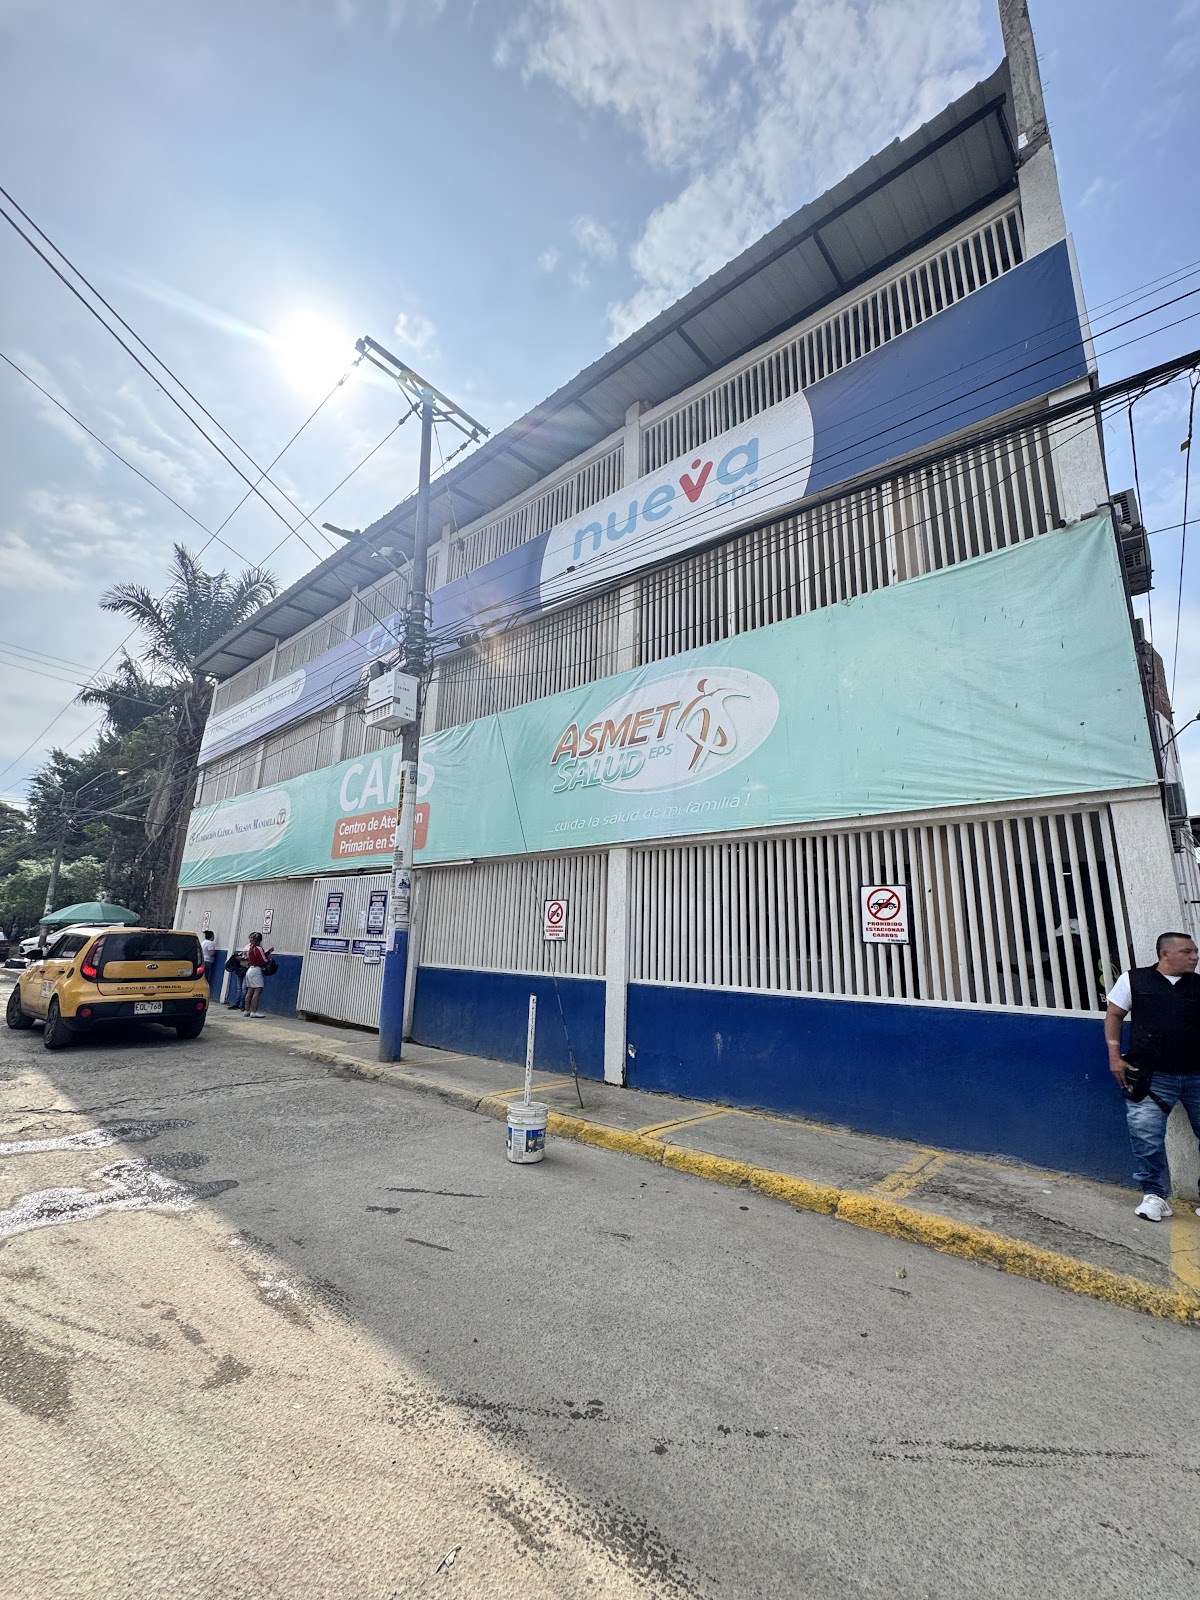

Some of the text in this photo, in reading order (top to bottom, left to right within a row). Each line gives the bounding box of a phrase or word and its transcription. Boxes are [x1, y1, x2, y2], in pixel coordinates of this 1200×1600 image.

[573, 437, 759, 561] nueva
[716, 478, 759, 507] eps
[550, 701, 681, 765] ASMET
[648, 743, 674, 760] EPS
[553, 750, 646, 793] SALUD
[339, 811, 423, 836] Centro de Aten
[587, 815, 600, 828] la
[602, 808, 641, 826] salud
[642, 806, 660, 819] de
[664, 804, 682, 816] mi
[685, 796, 741, 815] familia
[339, 836, 374, 854] Primaria
[376, 838, 387, 849] en
